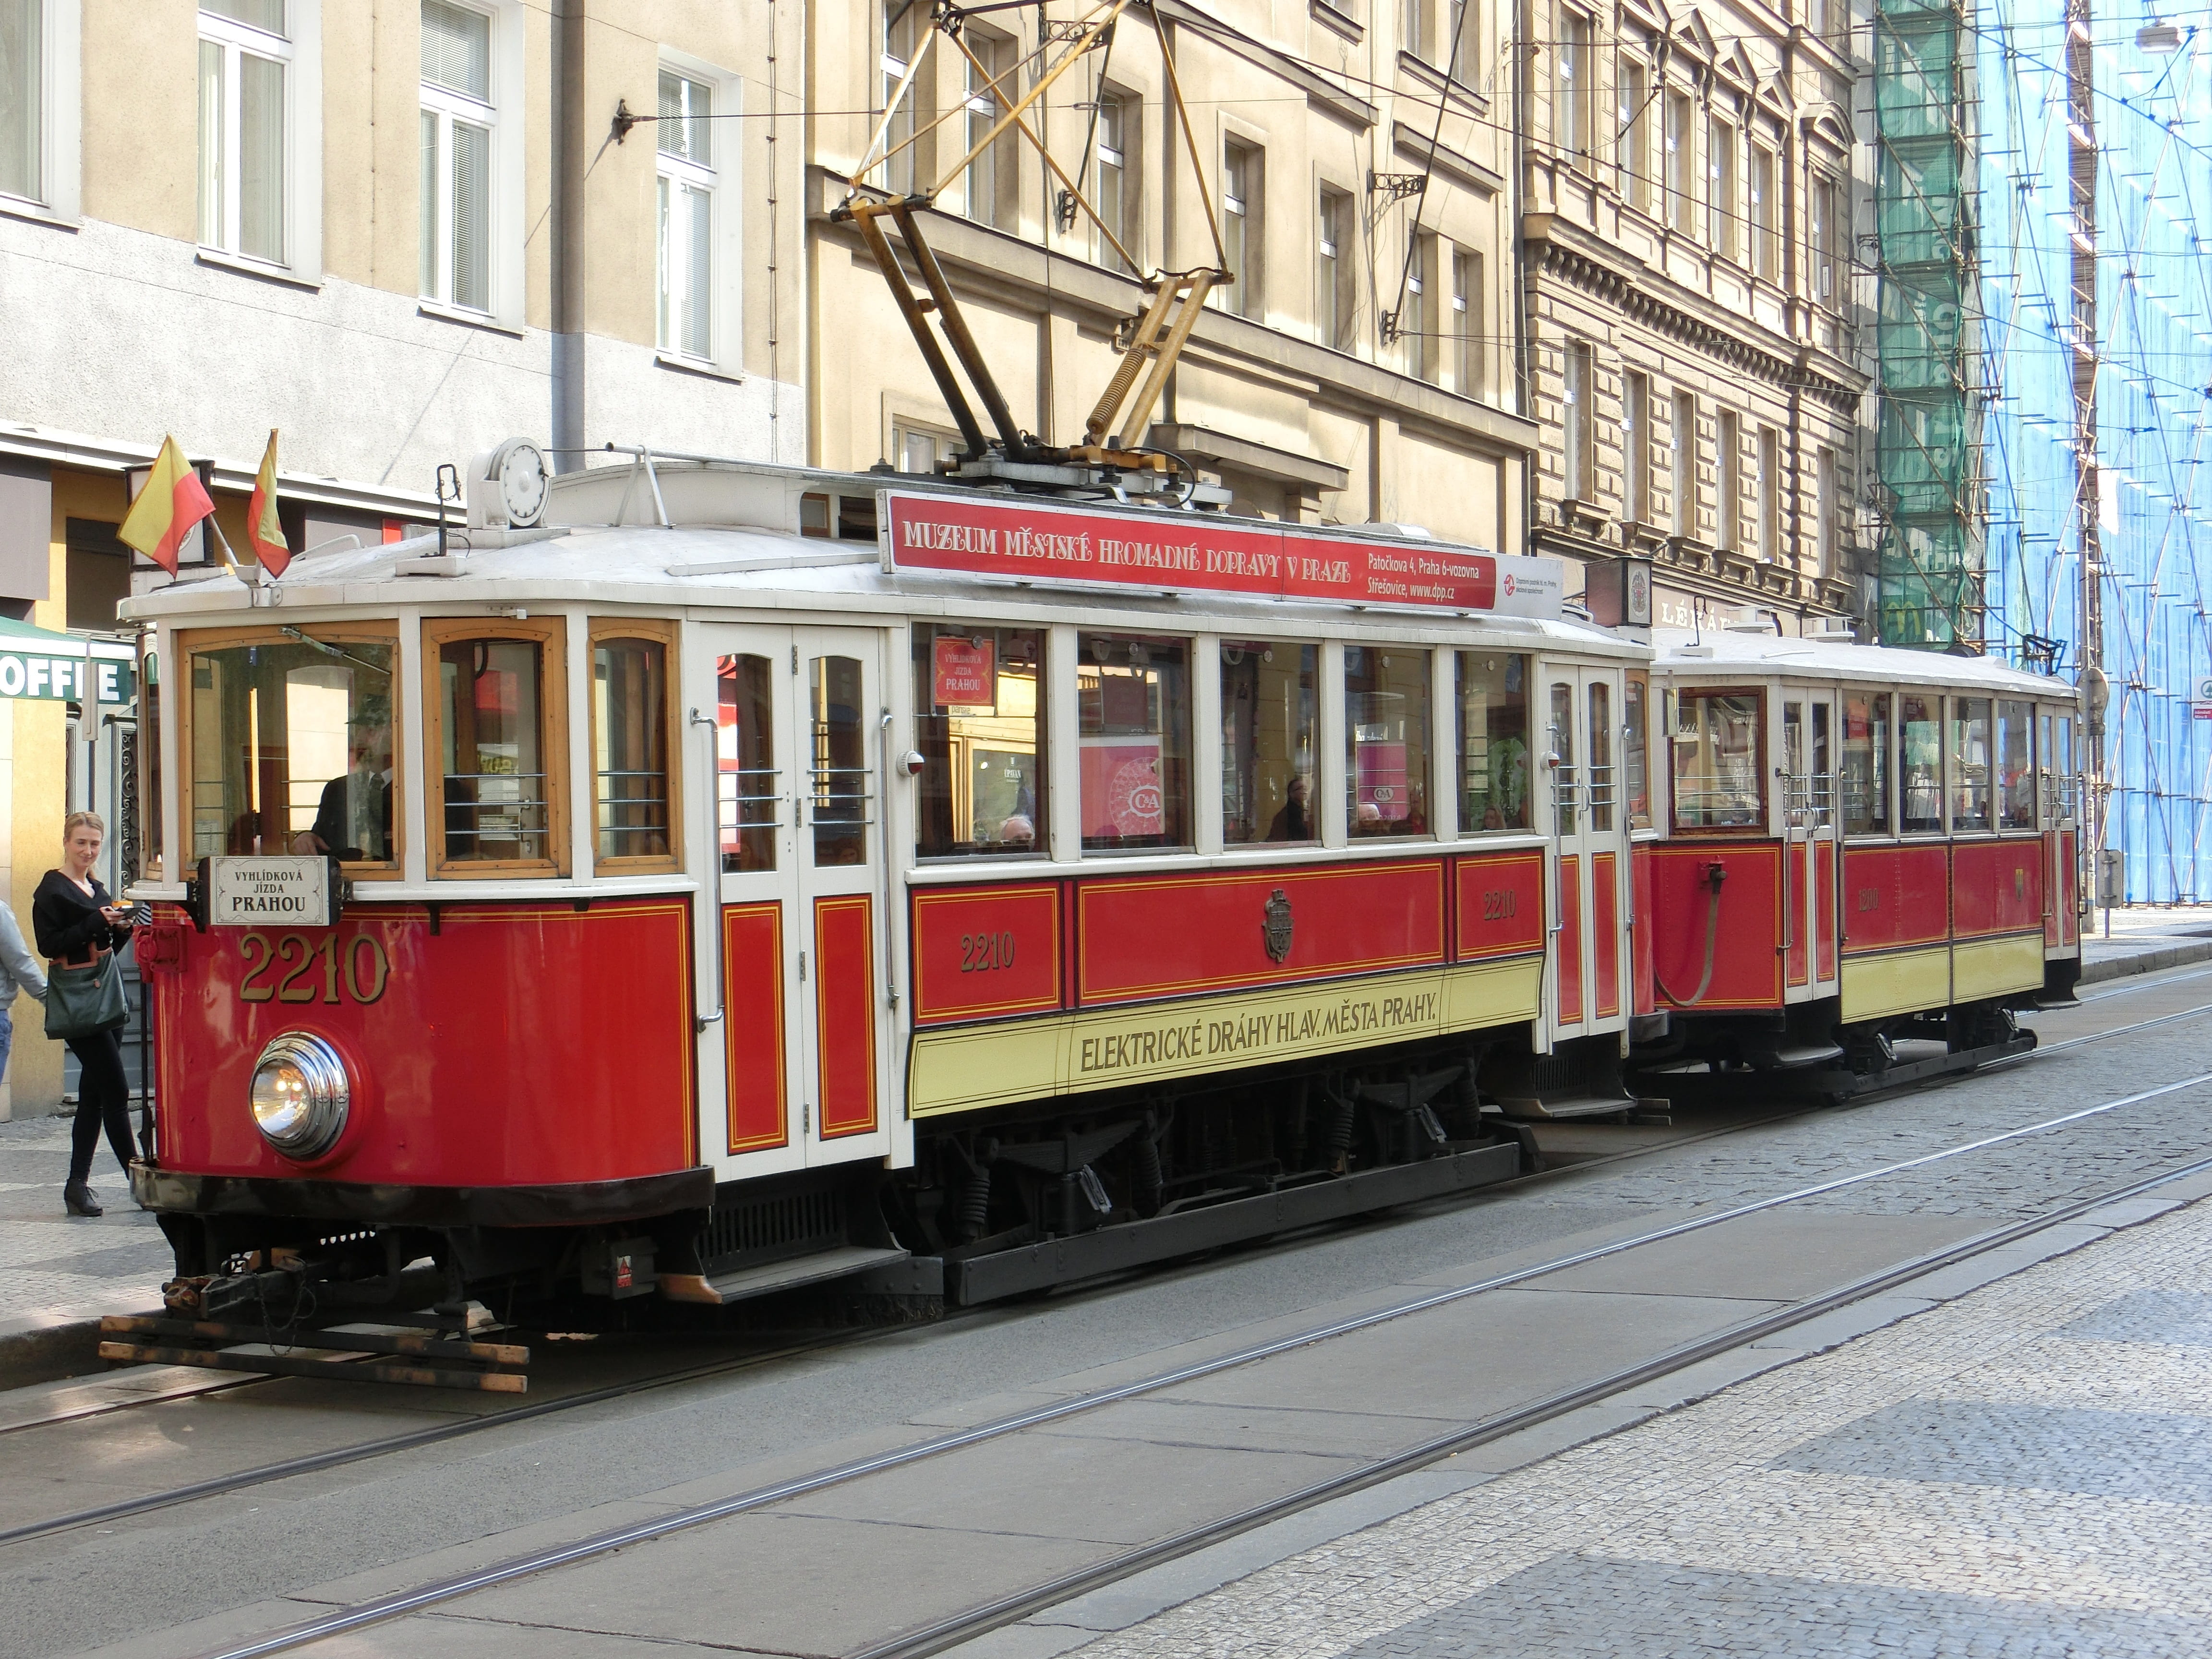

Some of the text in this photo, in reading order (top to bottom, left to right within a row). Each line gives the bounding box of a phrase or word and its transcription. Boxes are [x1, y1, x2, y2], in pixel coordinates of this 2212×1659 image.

[902, 521, 1351, 583] MUZEUM MĚSTSKÉ HROMADNÉ DOPRAVY V PRAZE
[1368, 553, 1479, 579] Patočkova 4, Praha 6-vozovna
[1368, 577, 1455, 602] Střešovice, www.dpp.cz
[946, 678, 980, 691] PRAHOU
[1135, 793, 1160, 809] C&A
[235, 869, 303, 881] VYHLÍDKOVÁ
[253, 881, 284, 893] JÍZDA
[232, 897, 305, 912] PRAHOU
[1484, 889, 1516, 921] 2210
[961, 931, 1014, 972] 2210
[240, 932, 389, 1005] 2210
[1081, 992, 1436, 1072] ELEKTRICKÉ DRÁHY HLAV. MĚSTA PRAHY.
